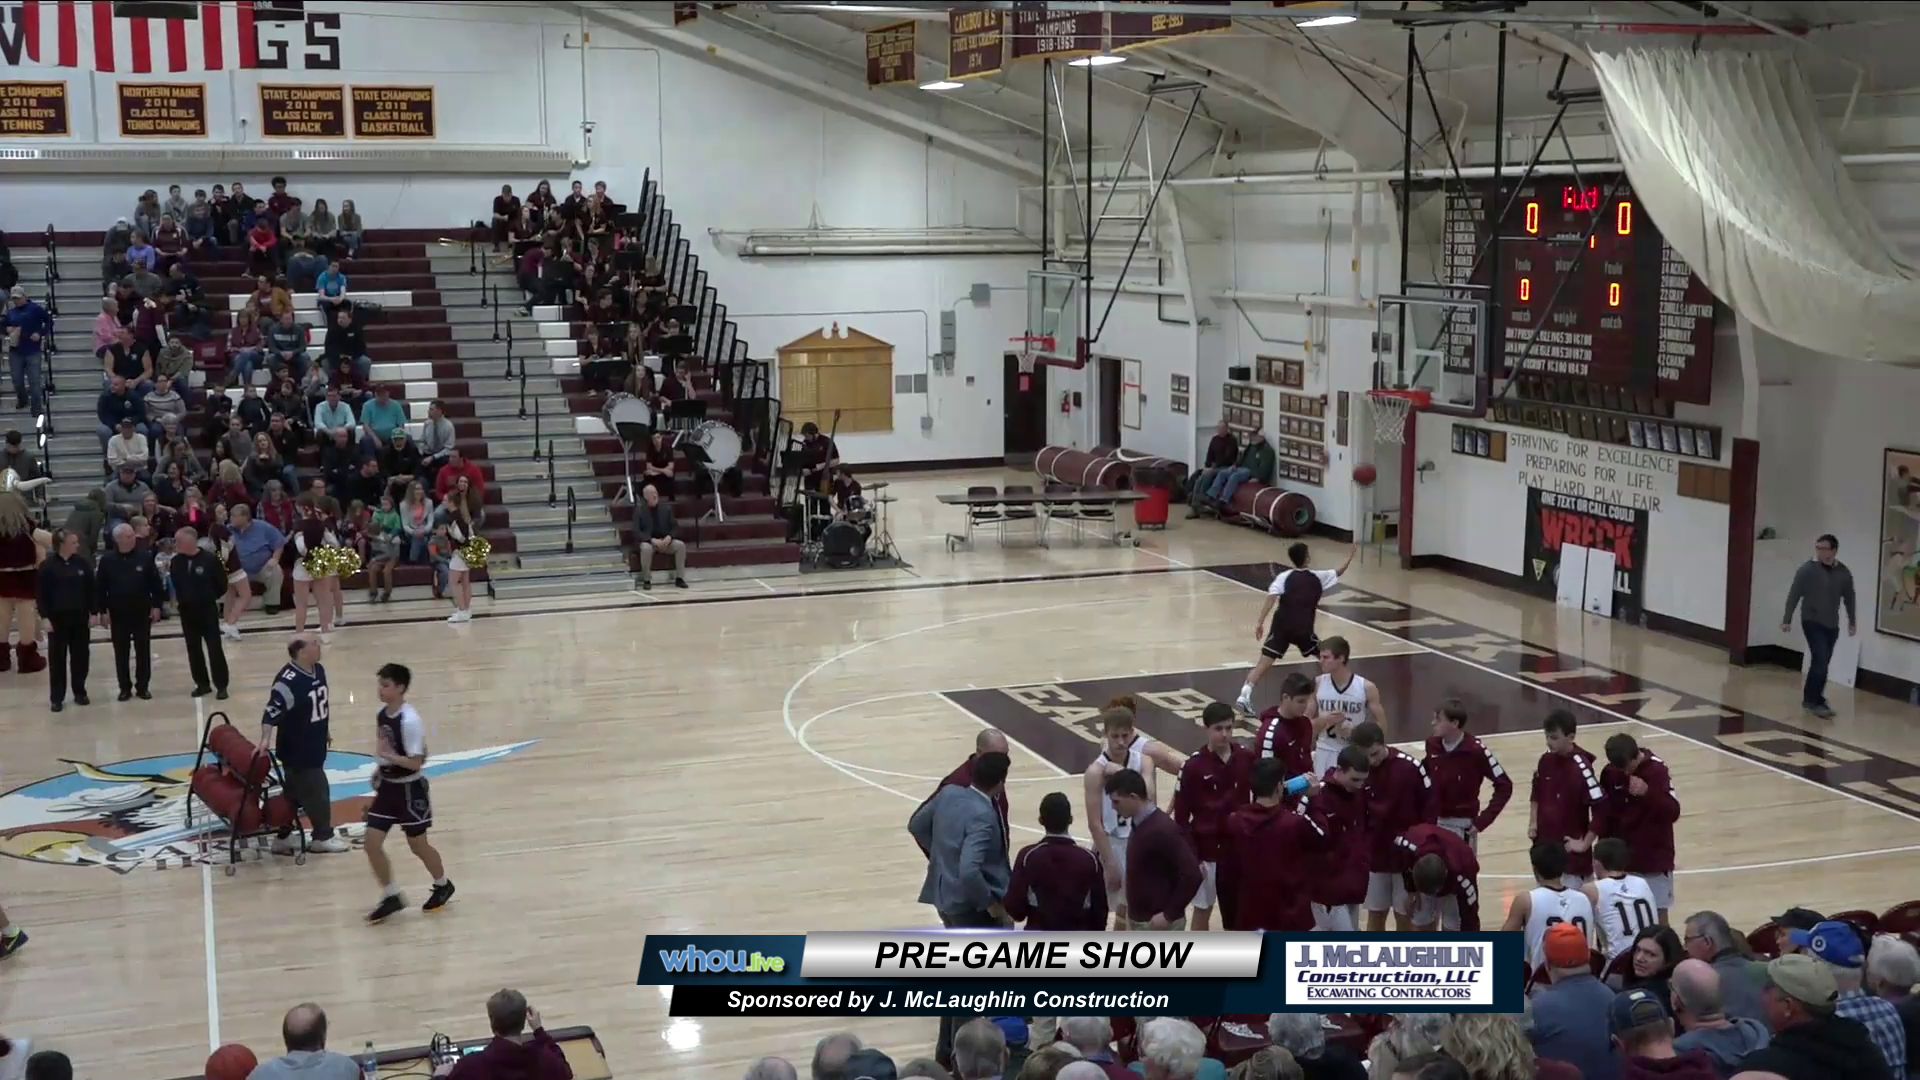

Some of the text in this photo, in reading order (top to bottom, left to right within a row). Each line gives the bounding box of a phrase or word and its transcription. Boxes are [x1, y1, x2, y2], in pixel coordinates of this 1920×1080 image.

[8, 87, 63, 97] CHAMPIONS
[123, 87, 200, 98] NORTHERN MAINE
[263, 90, 341, 101] STATE CHAMPIONS
[354, 90, 431, 102] STATE CHAMPIONS
[30, 108, 56, 118] BOYS
[130, 109, 159, 118] CLASS
[170, 109, 195, 118] GIRLS
[273, 111, 300, 120] CLASS
[310, 111, 334, 120] BOYS
[363, 111, 391, 120] CLASS
[401, 112, 424, 121] BOYS
[2, 120, 45, 131] TENNIS
[127, 119, 200, 130] TENNIS CHAMPIONS
[286, 121, 322, 133] TRACK
[361, 121, 426, 132] BASKETBALL
[1526, 203, 1538, 234] 0
[1617, 202, 1631, 234] 0
[1520, 278, 1530, 301] 0
[1609, 282, 1620, 307] 0
[1511, 433, 1558, 454] STRIVING
[1567, 441, 1589, 458] FOR
[1526, 453, 1657, 492] PREPARING FOR LIFE.
[1518, 471, 1664, 513] PLAY HARD PLAY FAIR.
[1541, 491, 1635, 523] ONE TEXT OR CALL COULD
[1541, 508, 1634, 569] WRECK
[282, 668, 296, 681] 12
[308, 685, 328, 723] 12
[1318, 700, 1363, 713] VIKINGS
[1615, 898, 1654, 936] 10
